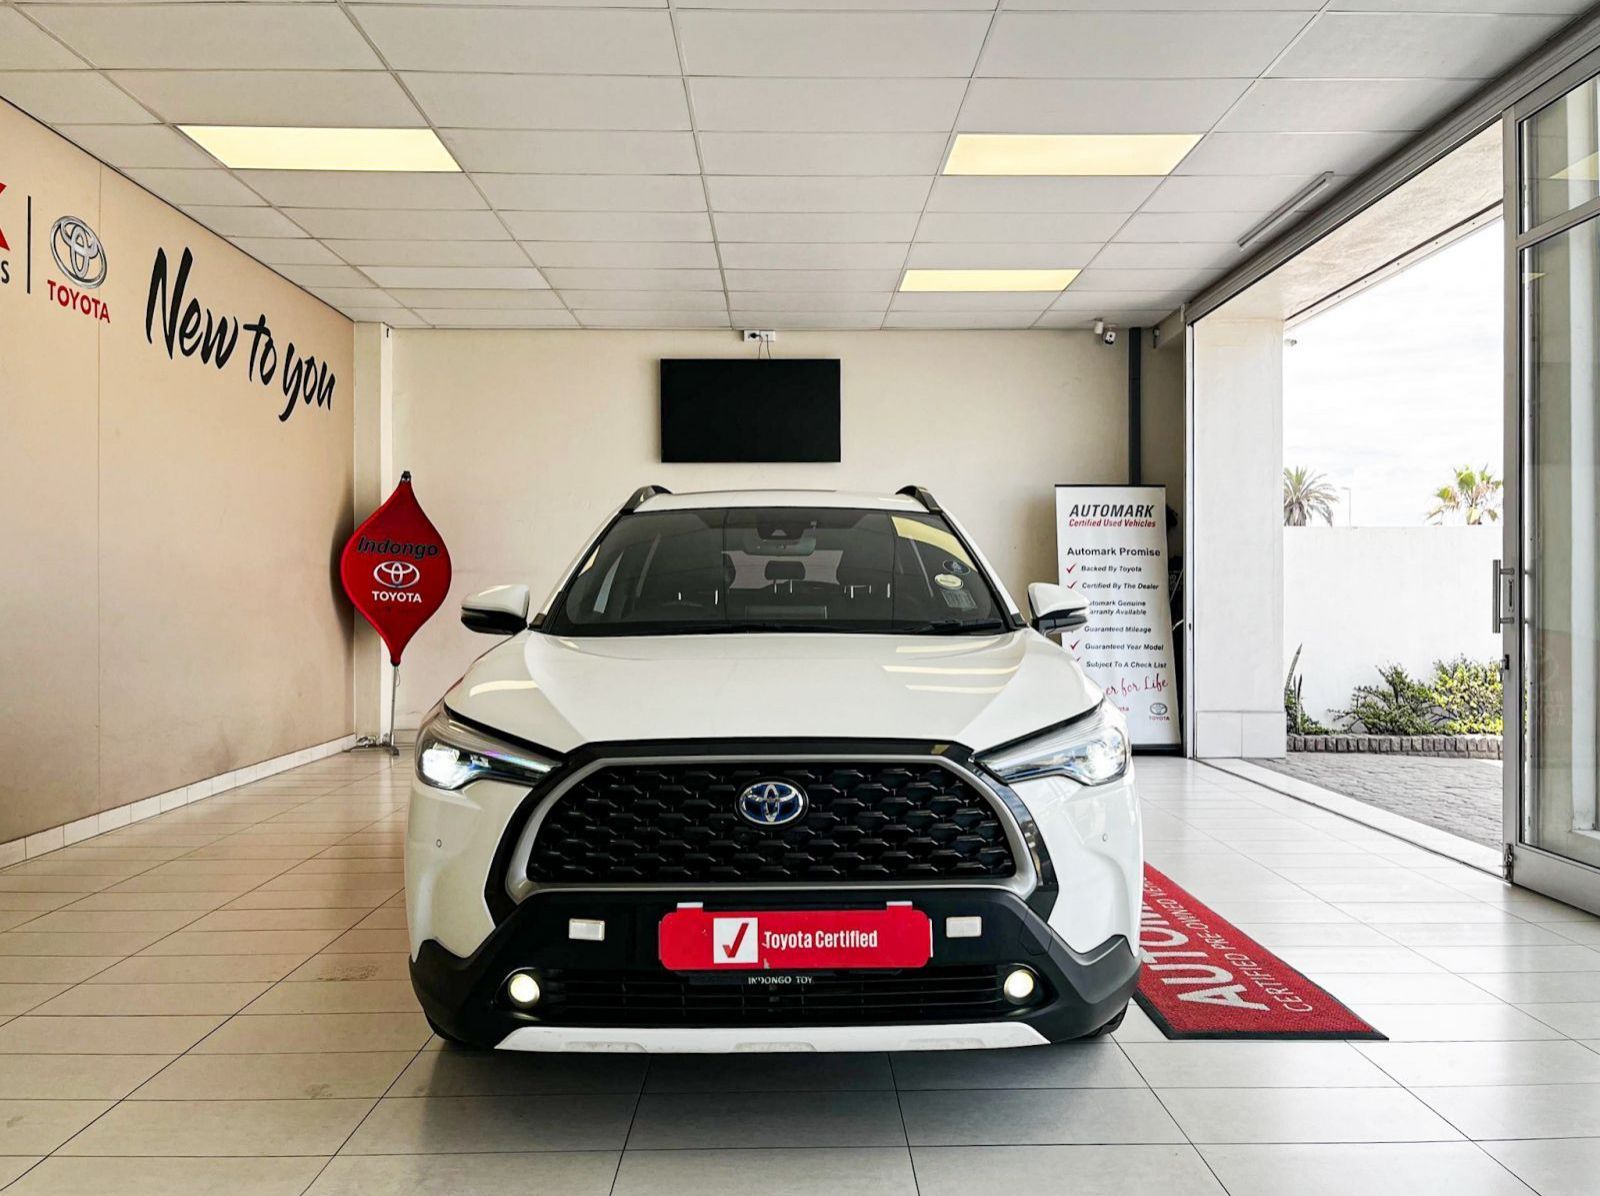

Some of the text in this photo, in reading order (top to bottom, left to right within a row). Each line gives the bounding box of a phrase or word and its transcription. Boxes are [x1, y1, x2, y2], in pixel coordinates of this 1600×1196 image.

[47, 279, 111, 324] TOYOTA
[145, 246, 336, 423] New to you
[1068, 503, 1155, 519] AUTOMARK
[1068, 518, 1156, 529] Certified Used Vehicles
[357, 535, 440, 560] Indongo
[1066, 546, 1161, 558] Automark Promise
[1081, 565, 1142, 574] Backed By Toyota
[1081, 582, 1111, 590] Certified
[1112, 583, 1122, 592] By
[1138, 583, 1159, 591] Dealer
[371, 590, 423, 604] TOYOTA
[1118, 599, 1147, 607] Genuine
[1084, 625, 1152, 634] Guaranteed Mileage
[1085, 643, 1164, 652] Guaranteed Year Model
[1086, 661, 1112, 669] Subject
[1130, 661, 1152, 669] Check
[763, 929, 878, 950] Toyota Certified
[1223, 952, 1313, 1013] CERTIFIED
